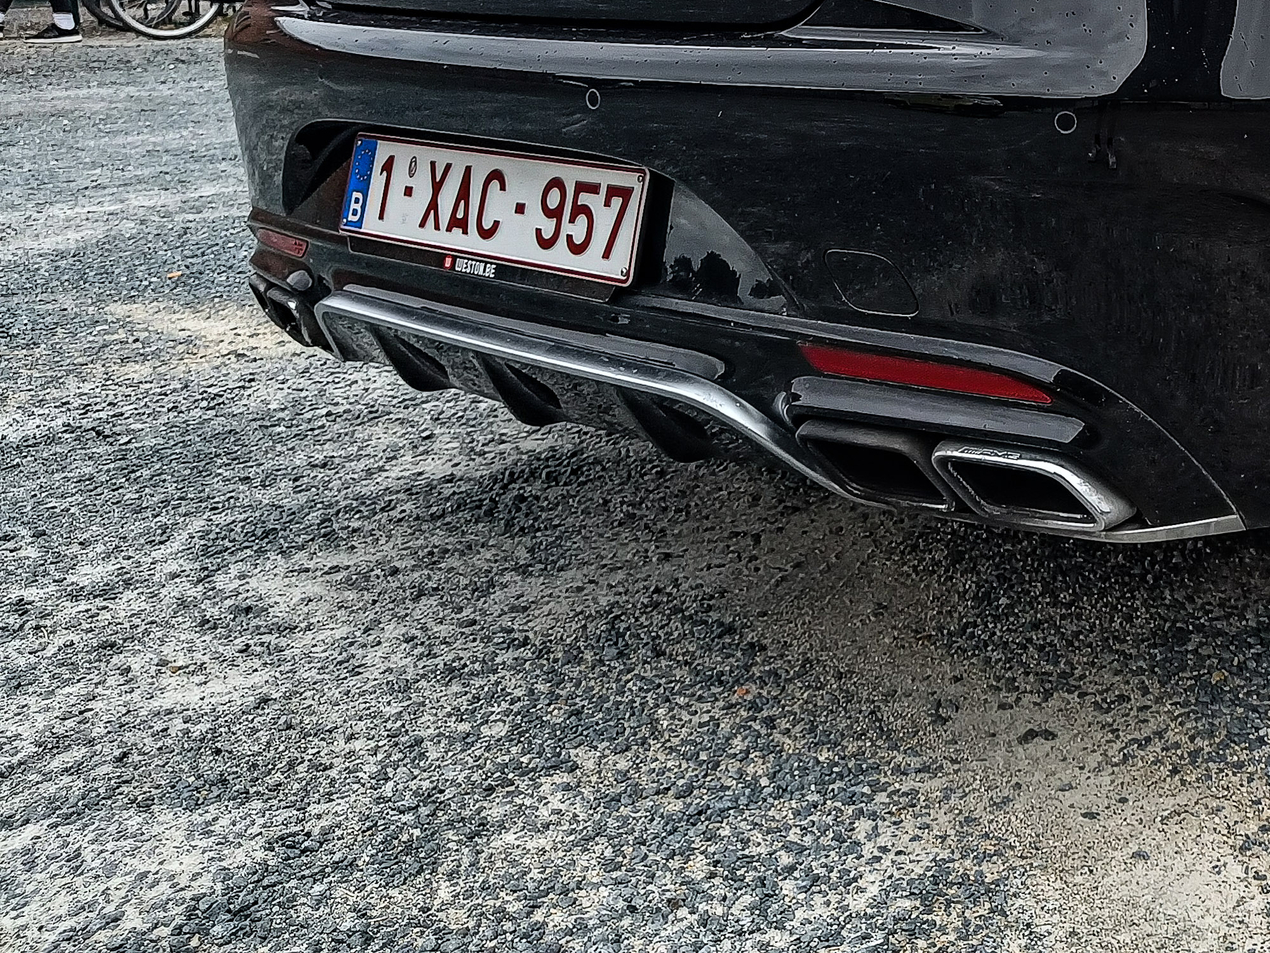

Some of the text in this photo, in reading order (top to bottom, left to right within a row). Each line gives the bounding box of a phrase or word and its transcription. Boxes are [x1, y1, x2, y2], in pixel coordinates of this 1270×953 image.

[346, 191, 364, 223] B
[377, 154, 635, 261] 1-XAC-957
[455, 258, 497, 278] WESTON.BE
